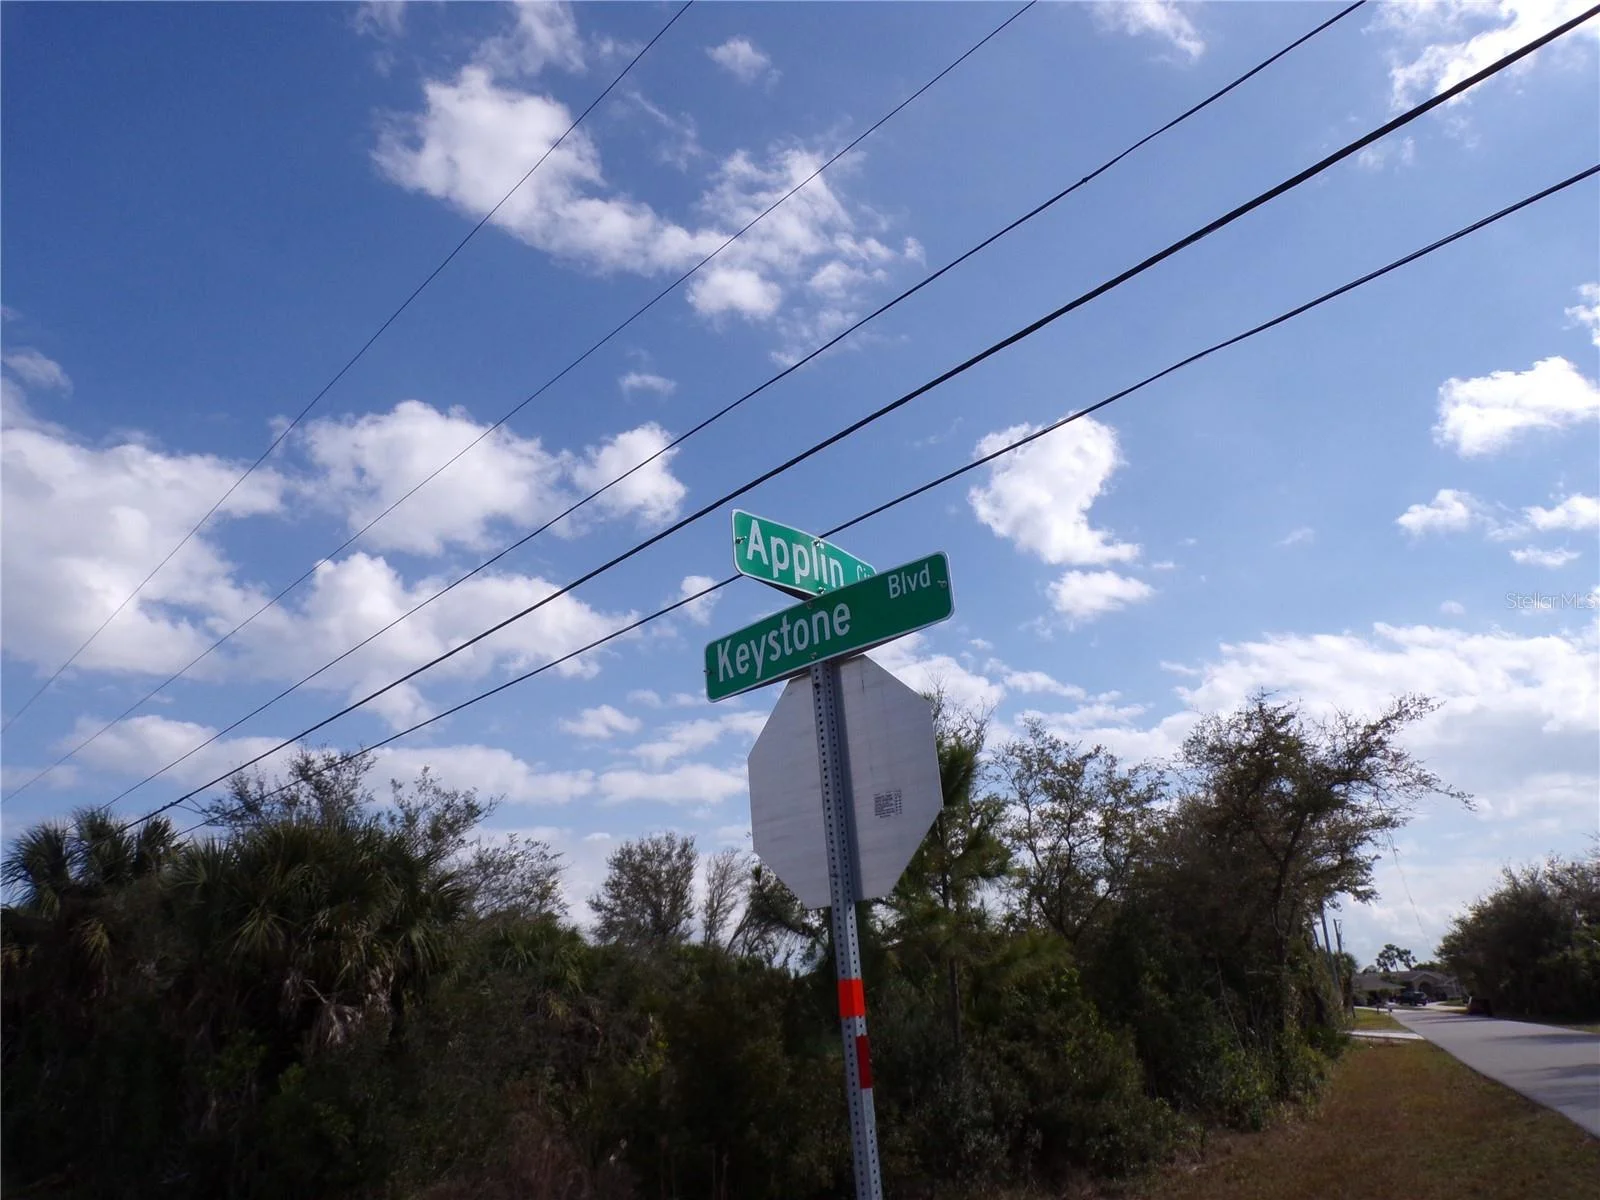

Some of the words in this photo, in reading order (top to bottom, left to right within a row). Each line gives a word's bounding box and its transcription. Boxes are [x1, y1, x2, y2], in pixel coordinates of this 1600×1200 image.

[746, 519, 844, 588] Applin
[716, 602, 851, 682] Keystone
[887, 563, 932, 599] Blvd
